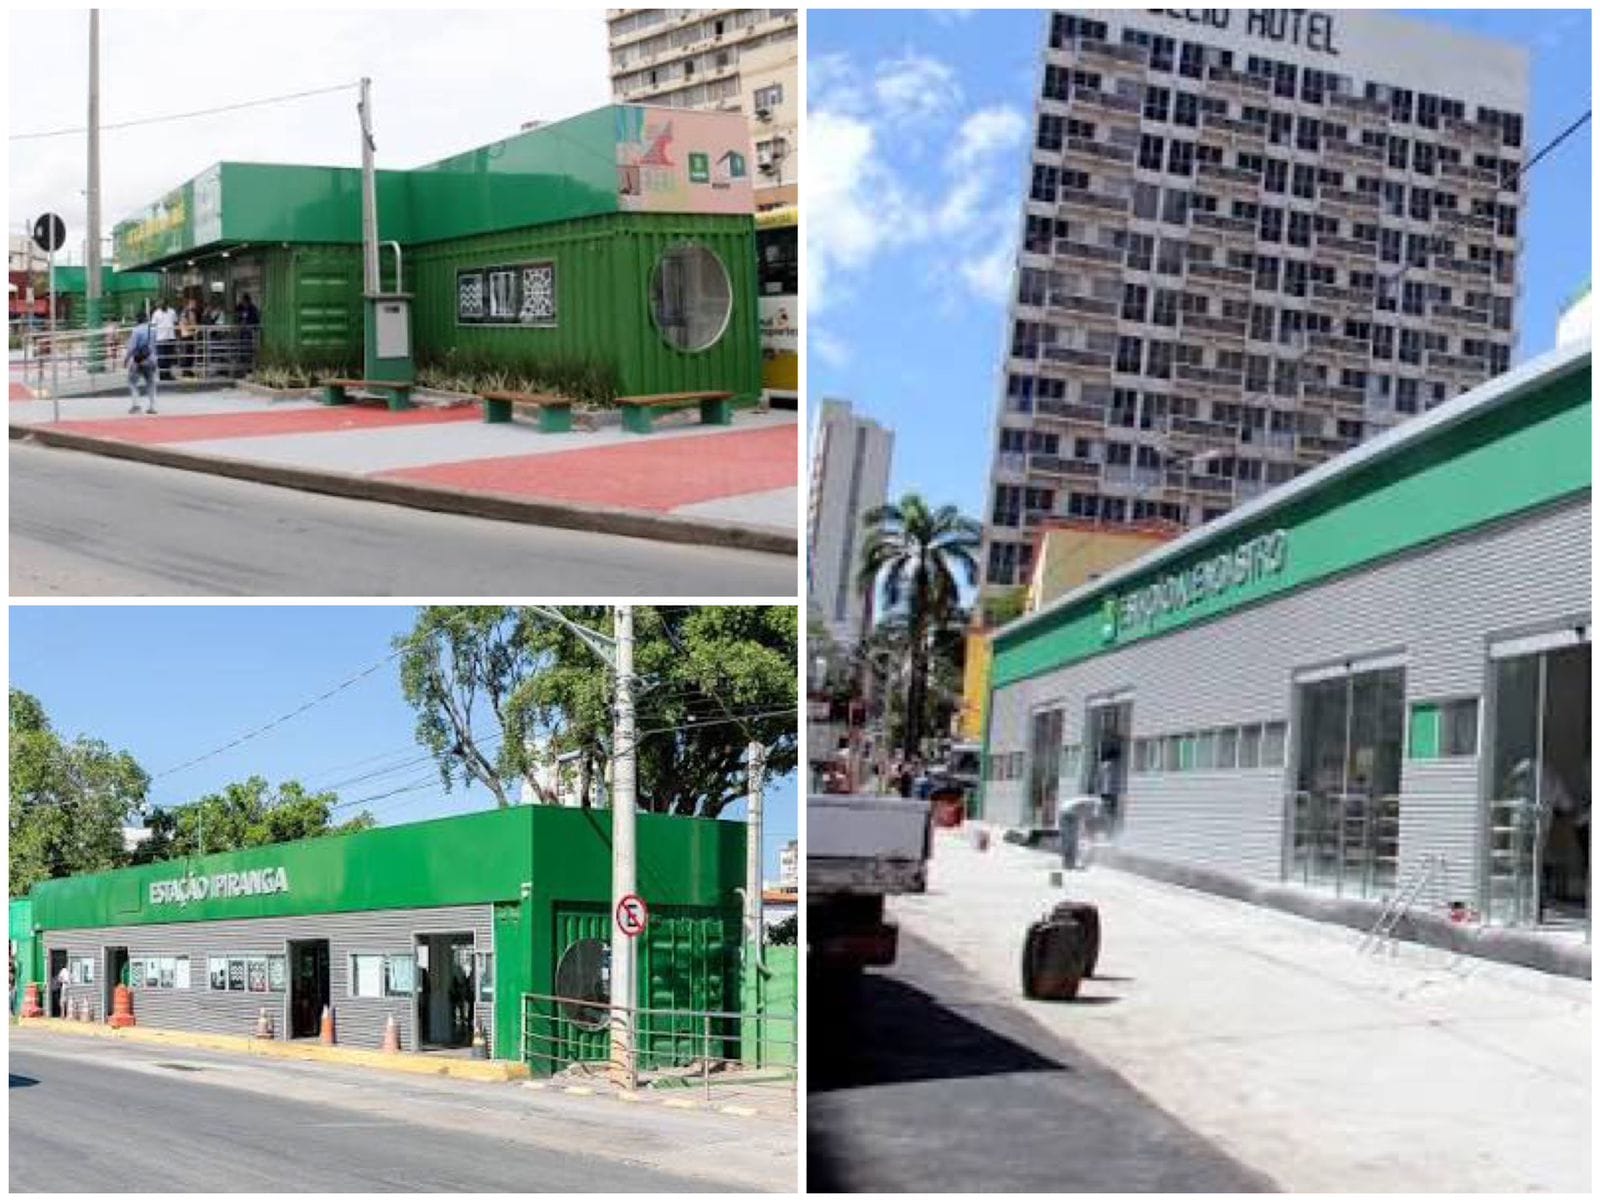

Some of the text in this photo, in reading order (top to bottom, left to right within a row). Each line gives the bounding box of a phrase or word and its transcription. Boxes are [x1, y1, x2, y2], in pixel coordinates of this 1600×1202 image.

[1248, 9, 1340, 55] HOTEL
[149, 867, 288, 909] ESTAÇÃO IPIRANGA
